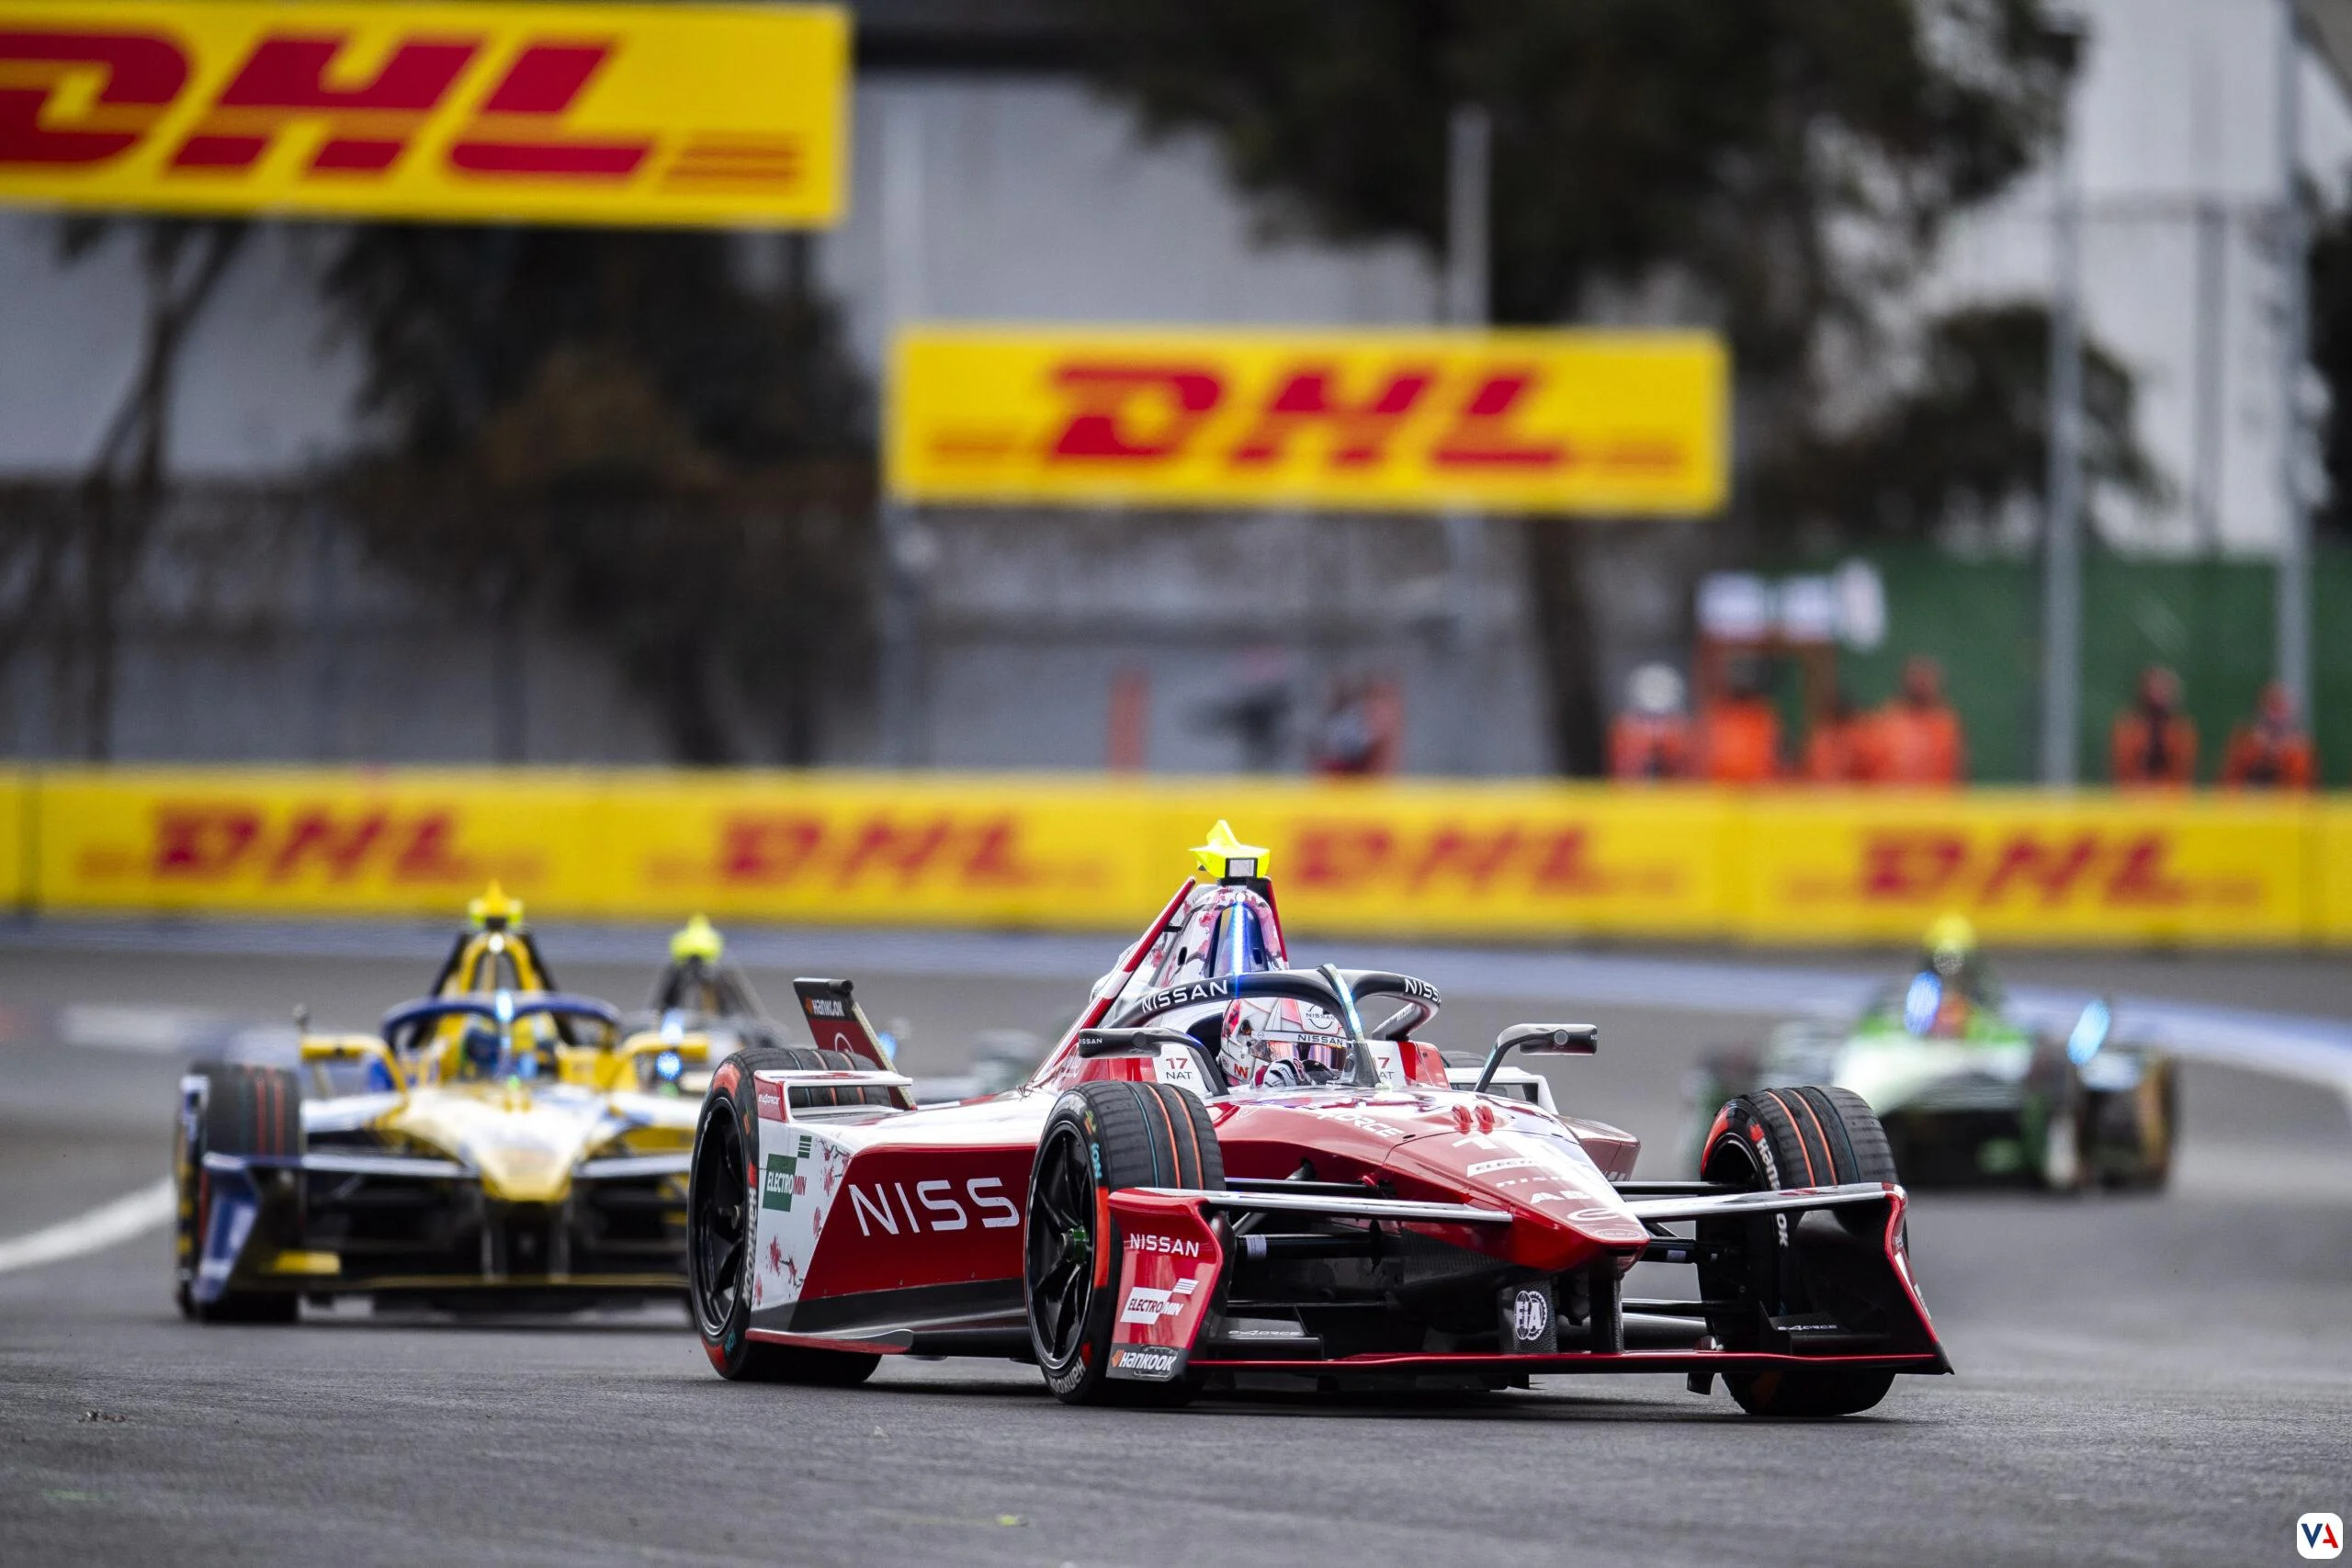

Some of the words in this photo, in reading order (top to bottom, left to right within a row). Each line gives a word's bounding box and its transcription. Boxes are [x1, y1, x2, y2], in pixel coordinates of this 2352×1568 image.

[0, 30, 653, 178] DHL
[1045, 361, 1566, 466] DHL
[153, 799, 467, 883] DHL
[720, 808, 1027, 886] DHL
[1293, 818, 1597, 895] DHL
[1861, 829, 2188, 905] DHL
[1141, 979, 1228, 1014] NISSAN
[1298, 1033, 1343, 1046] NISSAN
[1166, 1057, 1189, 1069] 17
[1166, 1071, 1193, 1079] NAT
[1379, 1071, 1395, 1079] AT
[766, 1173, 808, 1196] ELECTROMIN
[848, 1177, 1020, 1237] NISS
[1129, 1233, 1199, 1258] NISSAN
[1128, 1298, 1184, 1316] ELECTROMIN
[1515, 1301, 1543, 1331] FIA
